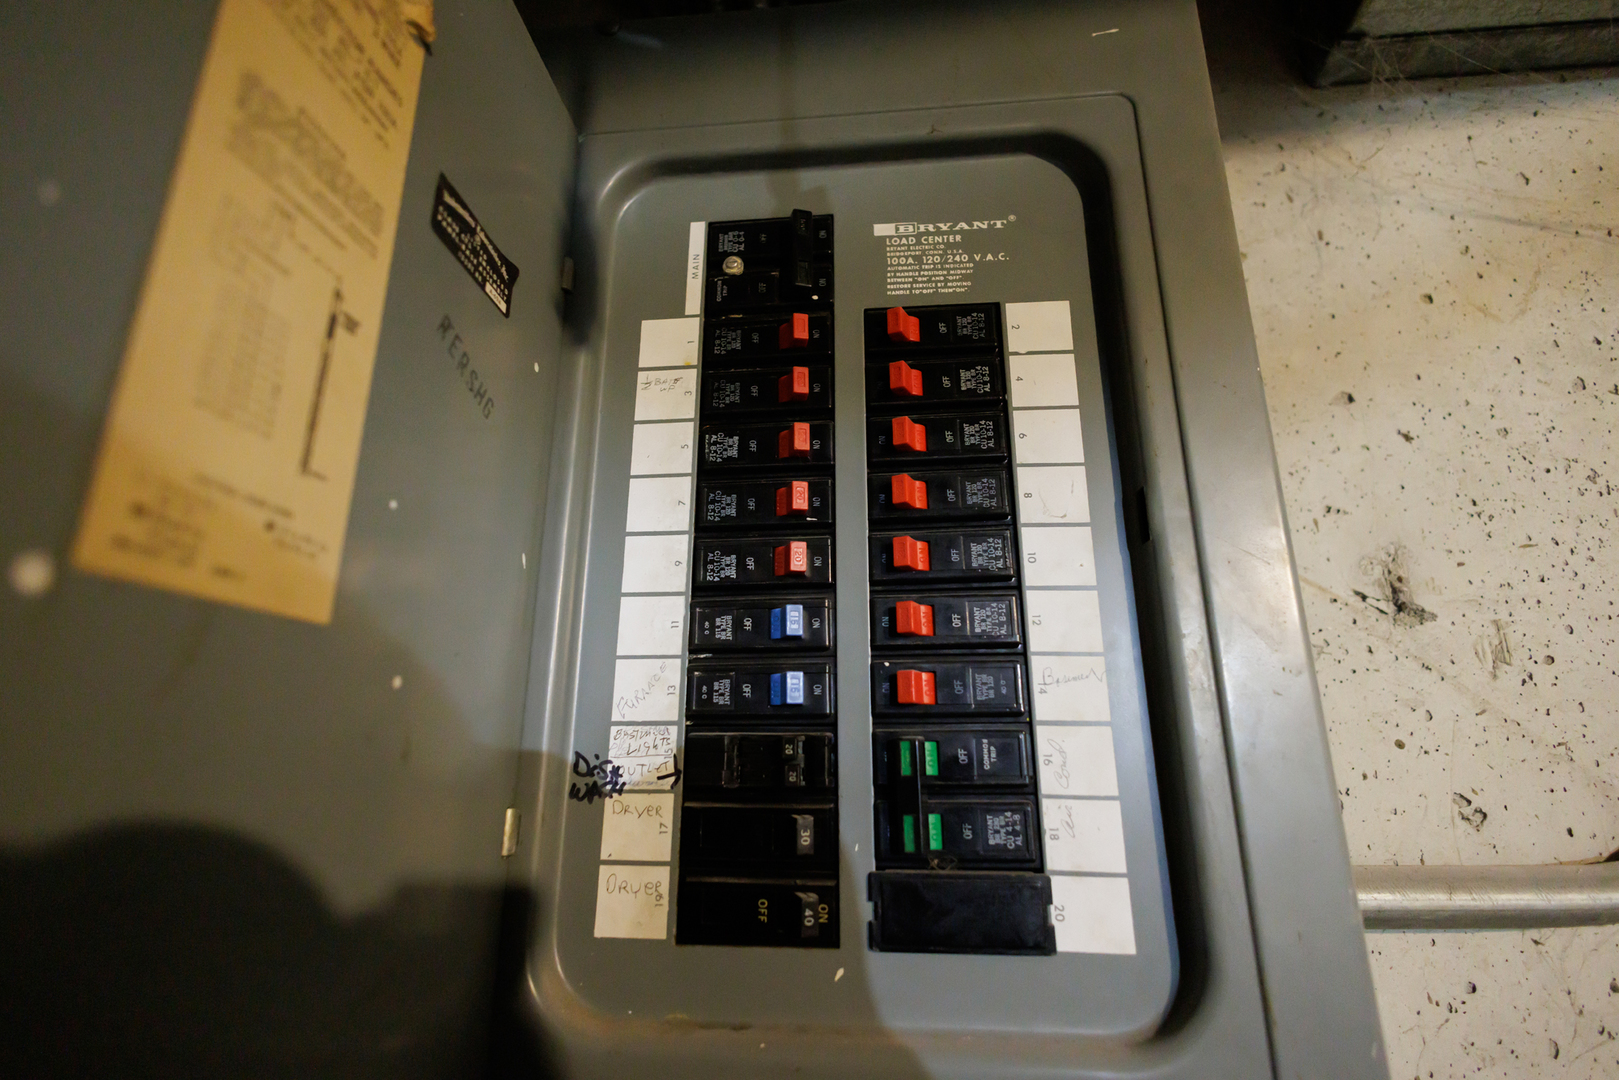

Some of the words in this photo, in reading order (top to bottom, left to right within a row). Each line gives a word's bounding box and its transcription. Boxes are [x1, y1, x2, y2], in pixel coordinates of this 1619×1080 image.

[896, 220, 1007, 235] BRYANT
[819, 230, 827, 238] ON
[886, 237, 916, 245] LOAD
[921, 235, 962, 244] CENTER
[887, 256, 917, 265] 100A.
[922, 254, 969, 264] 120/240
[974, 253, 1010, 261] V.A.C.
[692, 253, 700, 280] MAIN
[819, 278, 826, 287] ON
[939, 322, 947, 333] OFF
[813, 330, 820, 338] ON
[813, 383, 820, 392] ON
[942, 376, 951, 387] OFF
[986, 421, 994, 436] 8-12
[718, 433, 724, 442] CU
[945, 430, 954, 442] OFF
[813, 440, 820, 449] ON
[981, 439, 988, 449] CU
[988, 439, 994, 447] AL
[709, 493, 715, 501] AL
[715, 491, 722, 500] CU
[947, 489, 956, 501] OFF
[813, 497, 820, 506] ON
[983, 498, 990, 507] CU
[991, 497, 997, 506] AL
[987, 538, 995, 558] 10-14
[707, 553, 714, 562] AL
[714, 551, 720, 560] CU
[814, 556, 822, 566] ON
[951, 549, 960, 562] OFF
[1027, 552, 1037, 564] 10
[746, 557, 754, 570] OFF
[988, 560, 996, 570] CU
[996, 559, 1003, 568] AL
[670, 620, 679, 629] 11
[743, 618, 752, 631] OFF
[812, 618, 820, 628] ON
[882, 617, 889, 627] ON
[952, 613, 961, 627] OFF
[1032, 615, 1041, 626] 12
[992, 626, 999, 636] CU
[1000, 625, 1006, 634] AL
[667, 685, 676, 696] 13
[743, 684, 751, 698] OFF
[813, 684, 822, 694] ON
[882, 682, 889, 692] ON
[954, 680, 963, 694] OFF
[975, 673, 983, 700] BRYANT
[1037, 682, 1048, 694] 14
[664, 748, 673, 760] 15
[785, 744, 793, 754] 20
[982, 739, 990, 770] COMMON
[958, 749, 968, 764] OFF
[1043, 753, 1053, 766] 16
[789, 771, 796, 782] 20
[1005, 811, 1013, 832] 4-14
[1013, 814, 1021, 830] 4-8
[659, 823, 668, 835] 17
[963, 823, 972, 839] OFF
[987, 815, 995, 845] BRYANT
[1049, 827, 1060, 841] 18
[801, 829, 810, 845] 30
[1007, 835, 1015, 849] CU
[1015, 834, 1022, 846] AL
[758, 899, 768, 923] OFF
[805, 908, 814, 926] 40
[819, 904, 828, 923] ON
[1054, 905, 1065, 922] 20
